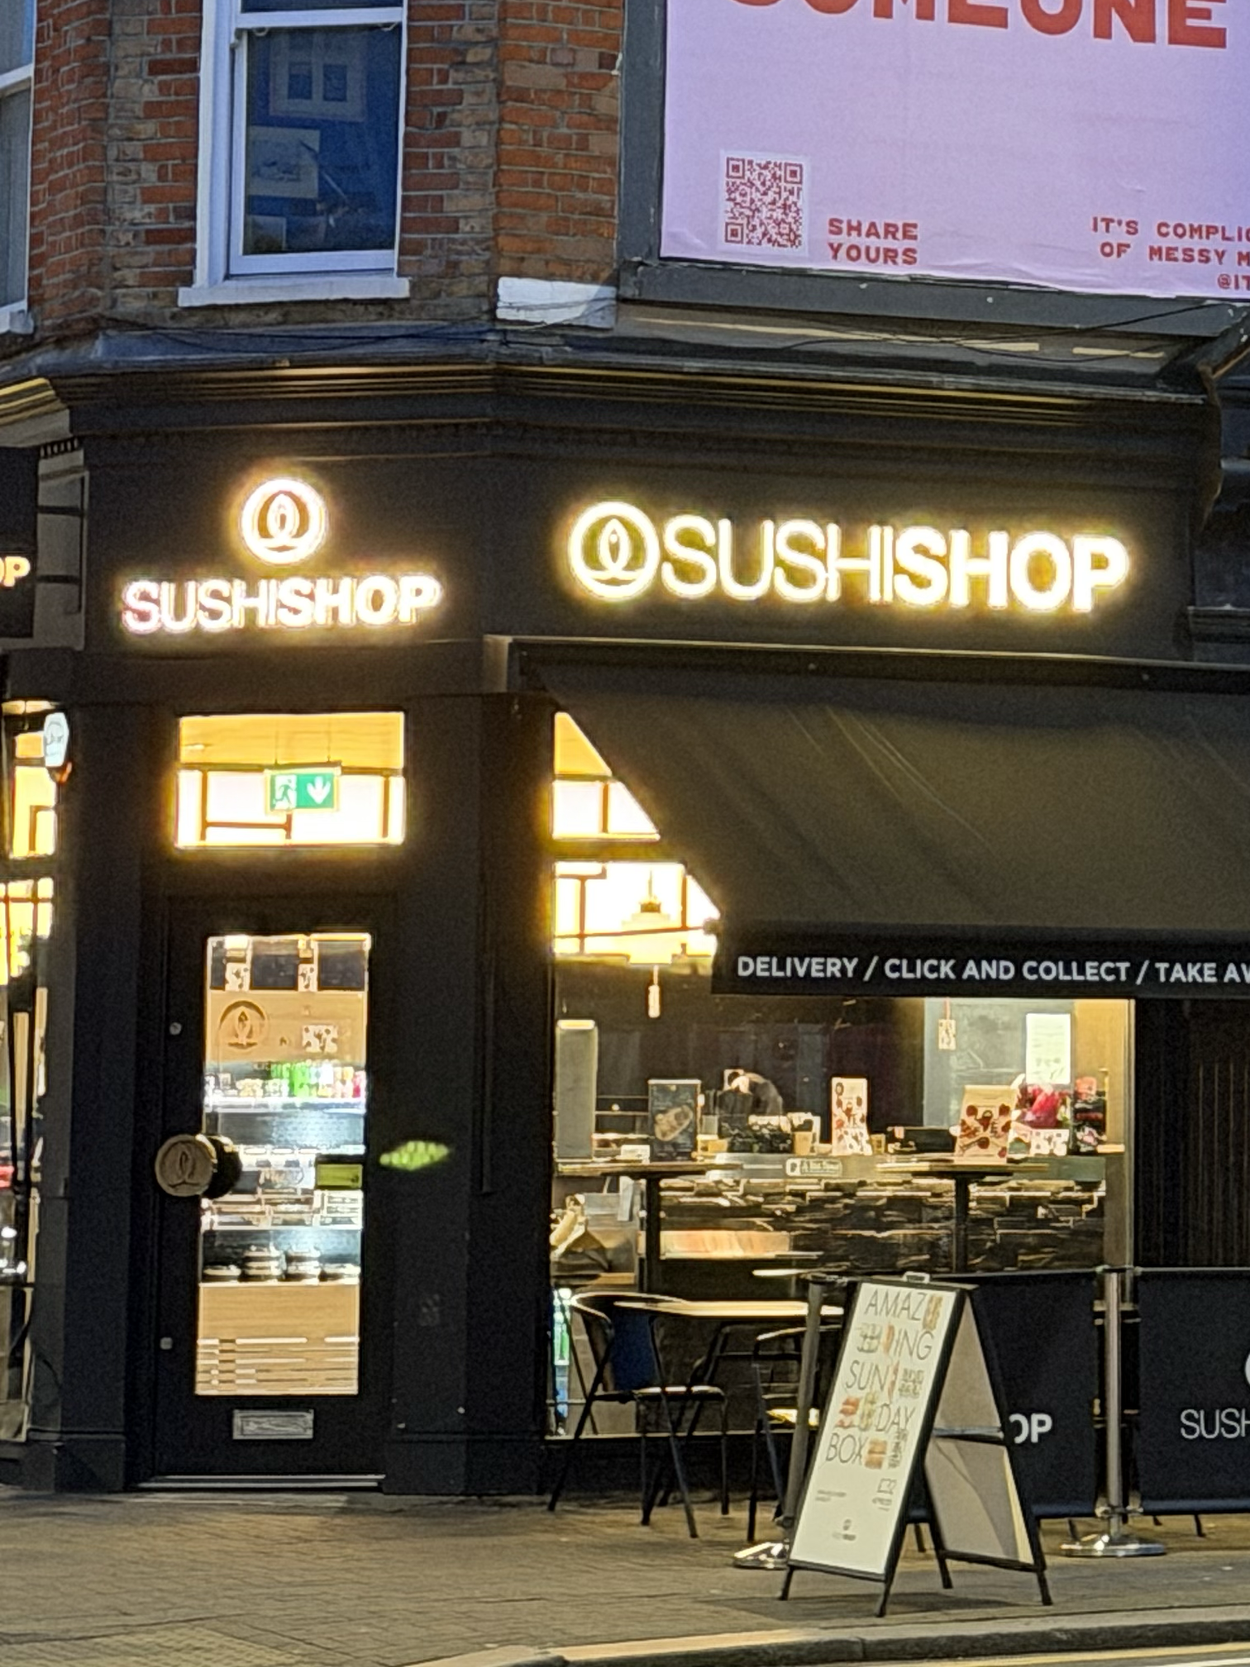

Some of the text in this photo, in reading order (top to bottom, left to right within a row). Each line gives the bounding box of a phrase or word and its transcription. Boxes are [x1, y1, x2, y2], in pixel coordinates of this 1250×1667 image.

[827, 217, 919, 242] SHARE
[1091, 216, 1139, 236] IT'S
[827, 242, 919, 266] YOURS
[1099, 241, 1131, 259] OF
[1148, 245, 1227, 266] MESSY
[661, 514, 1130, 613] SUSHISHOP
[122, 574, 444, 634] SUSHISHOP
[737, 955, 859, 979] DELIVERY
[884, 957, 957, 981] CLICK
[961, 959, 1016, 981] AND
[1022, 959, 1131, 983] COLLECT
[1154, 962, 1217, 983] TAKE
